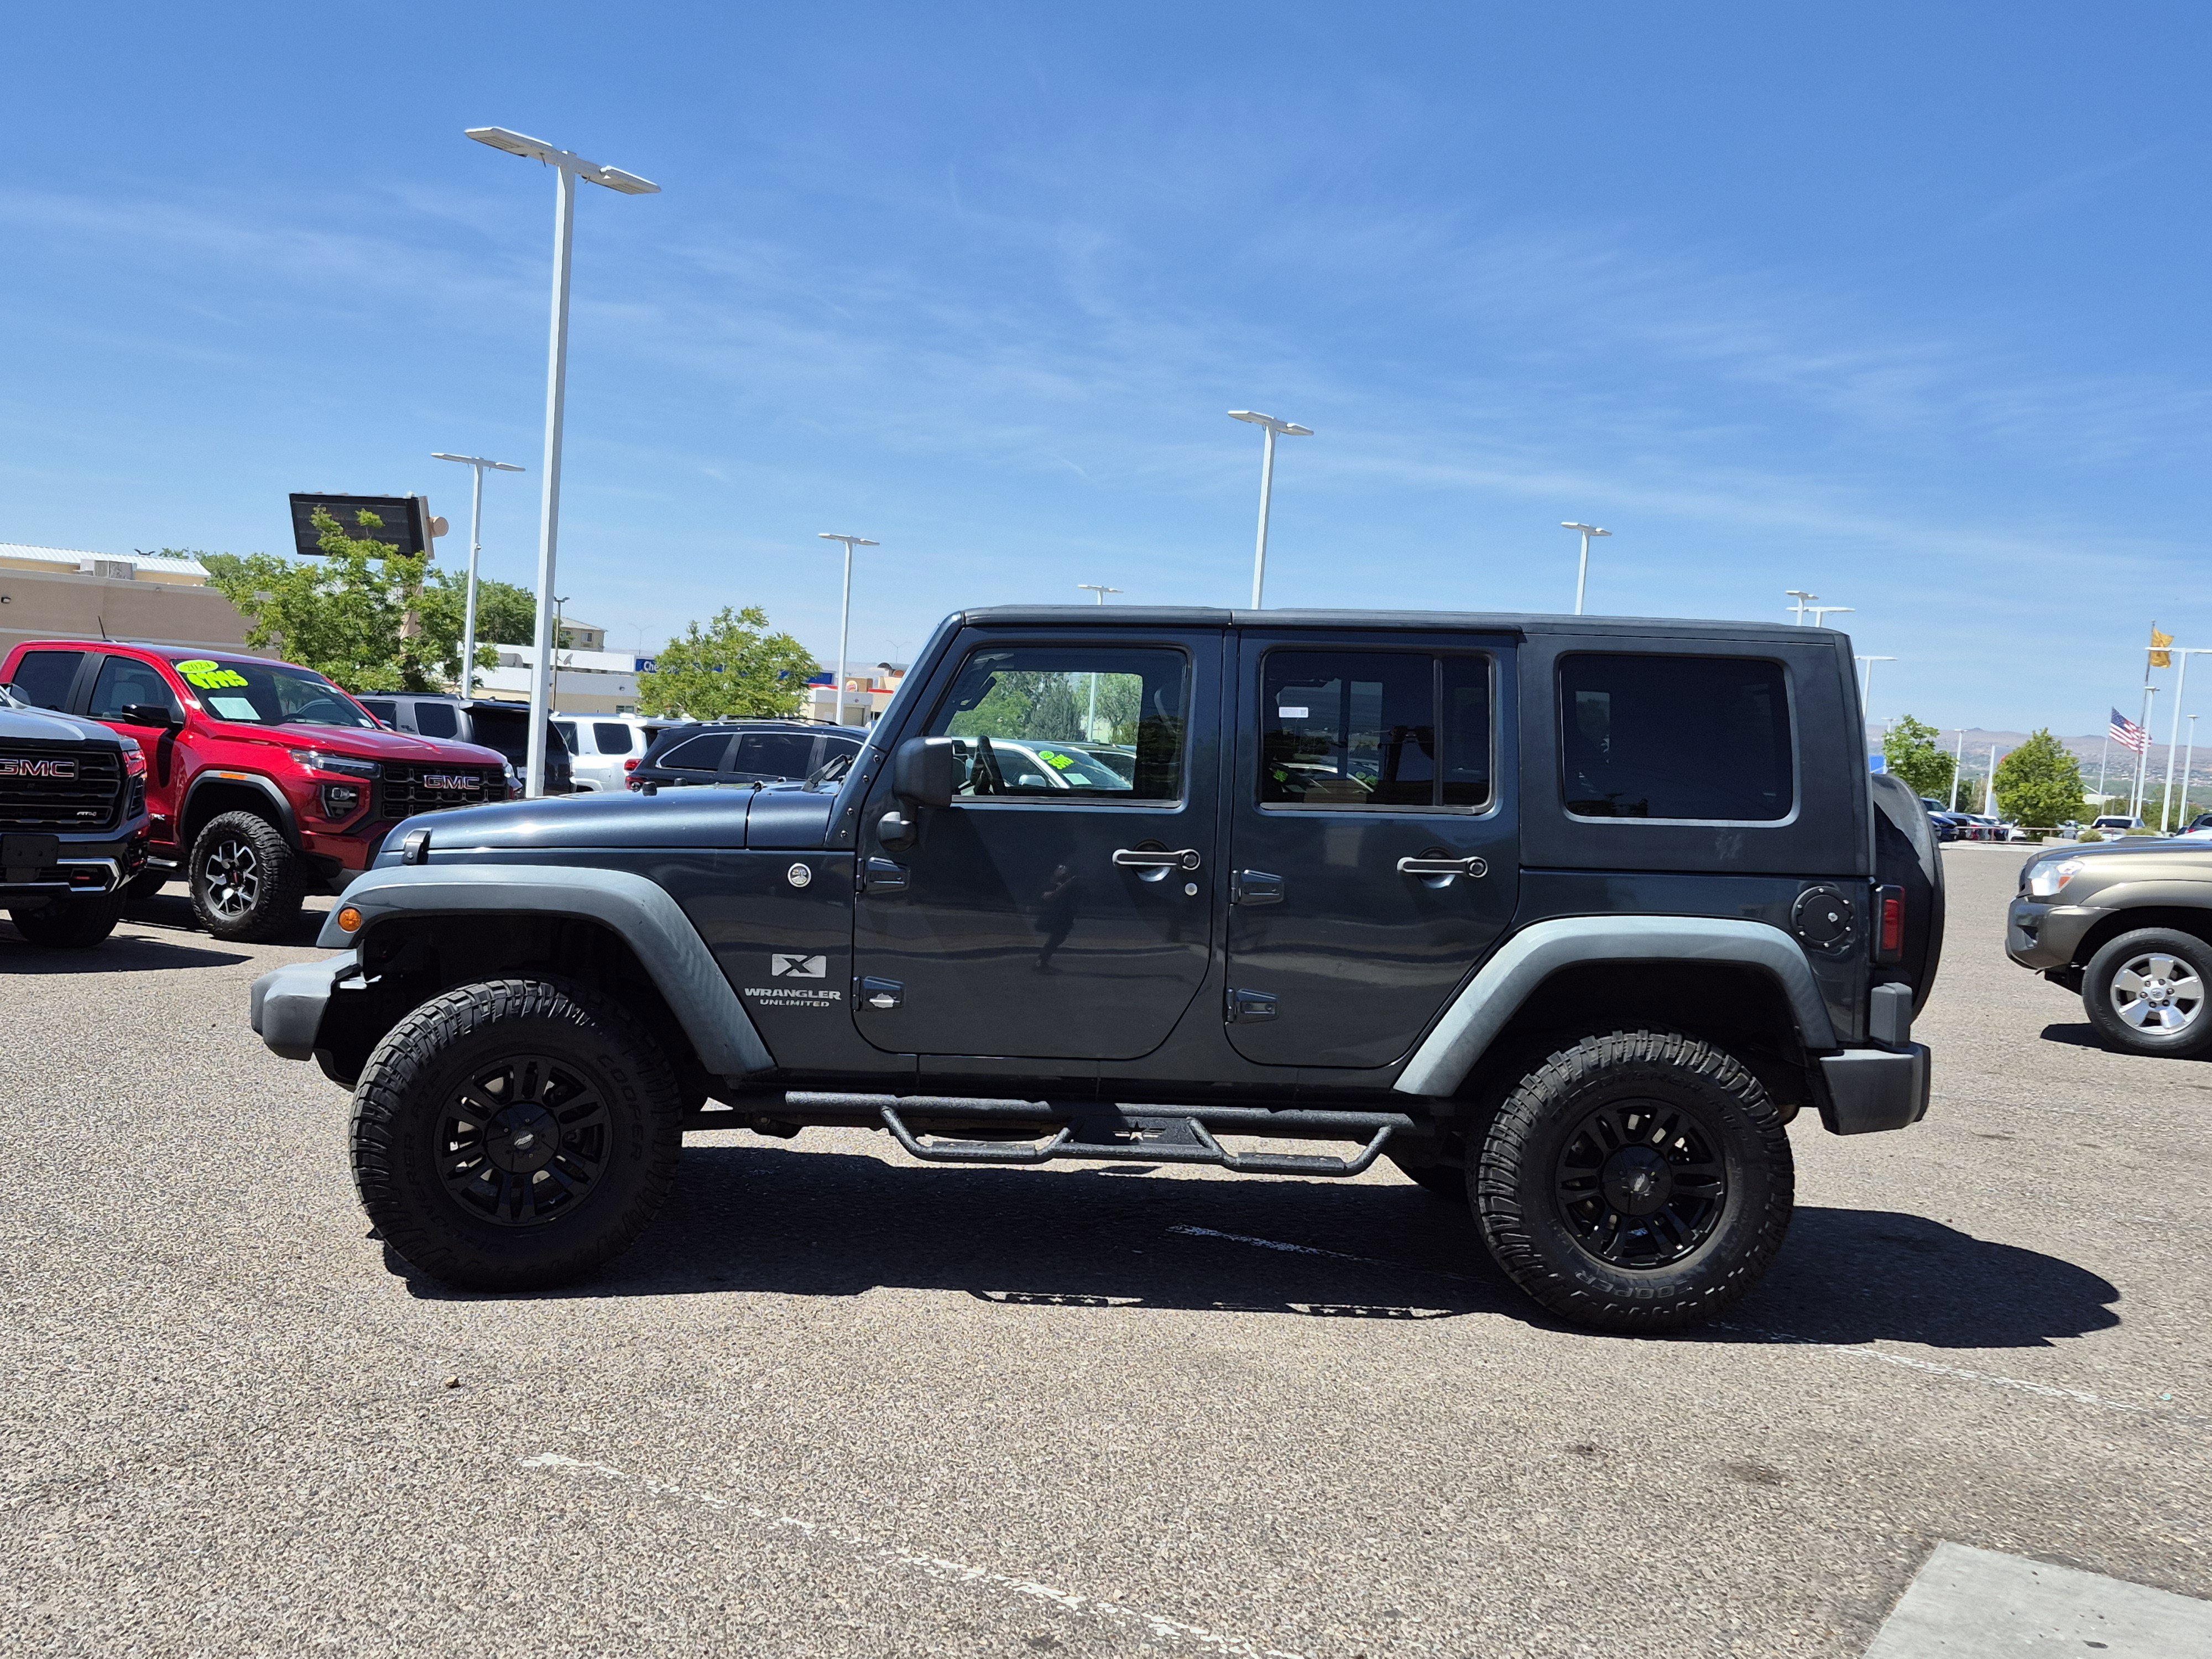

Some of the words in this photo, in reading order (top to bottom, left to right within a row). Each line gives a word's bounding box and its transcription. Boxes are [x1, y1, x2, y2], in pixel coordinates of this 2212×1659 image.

[184, 661, 211, 672] 2024
[644, 661, 677, 673] Cheon
[0, 758, 75, 777] GMC
[424, 775, 480, 790] GMC
[744, 988, 842, 1000] WRANGLER
[760, 999, 830, 1007] UNLIMITED
[597, 1053, 644, 1160] COOPER
[1574, 1270, 1694, 1300] COOPER
